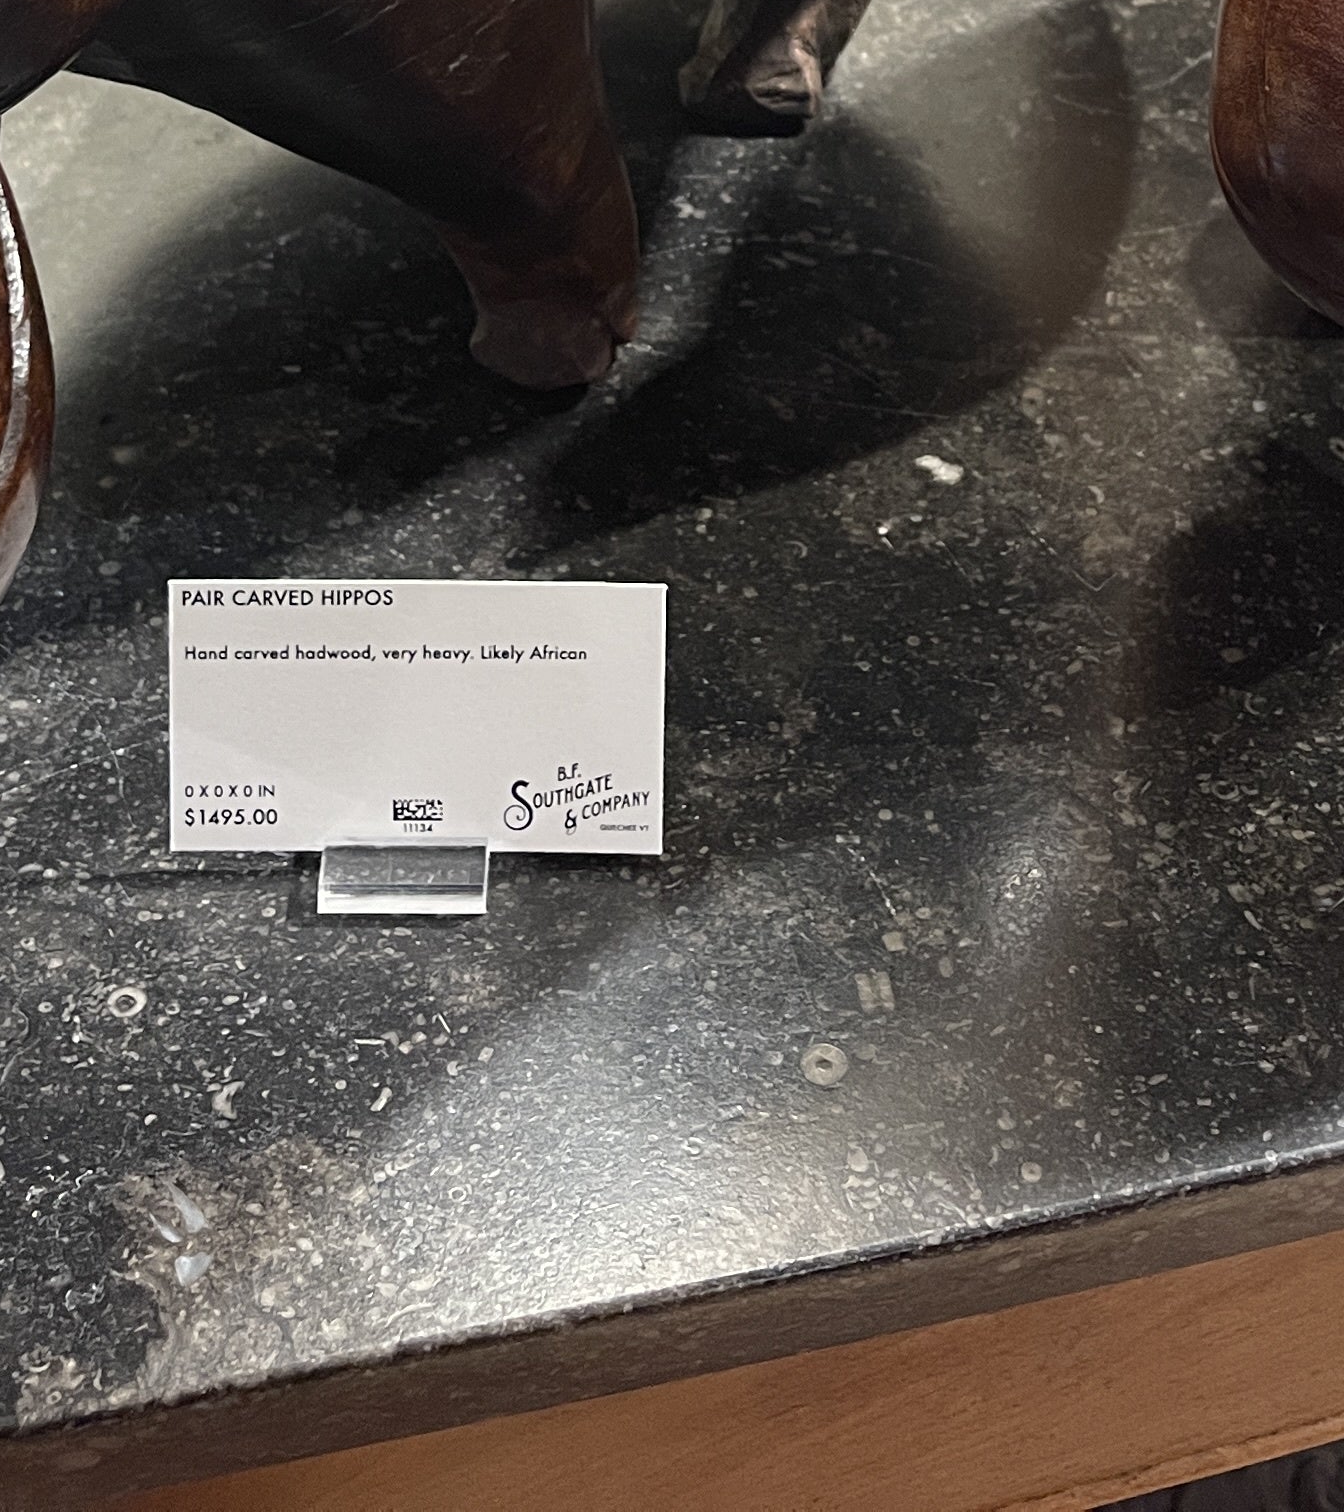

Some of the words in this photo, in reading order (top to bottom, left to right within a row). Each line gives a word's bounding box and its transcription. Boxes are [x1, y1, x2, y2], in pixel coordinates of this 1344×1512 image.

[182, 590, 225, 606] PAIR
[232, 590, 314, 606] CARVED
[321, 590, 394, 606] HIPPOS
[185, 645, 228, 660] Hand
[234, 645, 290, 660] carved
[295, 644, 377, 662] hadwood,
[382, 649, 417, 664] very
[422, 644, 474, 664] heavy.
[480, 644, 524, 664] Likely
[529, 644, 587, 660] African
[199, 785, 209, 797] X
[228, 785, 238, 797] X
[258, 785, 276, 797] IN
[503, 773, 613, 831] SOUTHGATE
[582, 791, 650, 819] COMPANY
[184, 808, 278, 827] $1495.00
